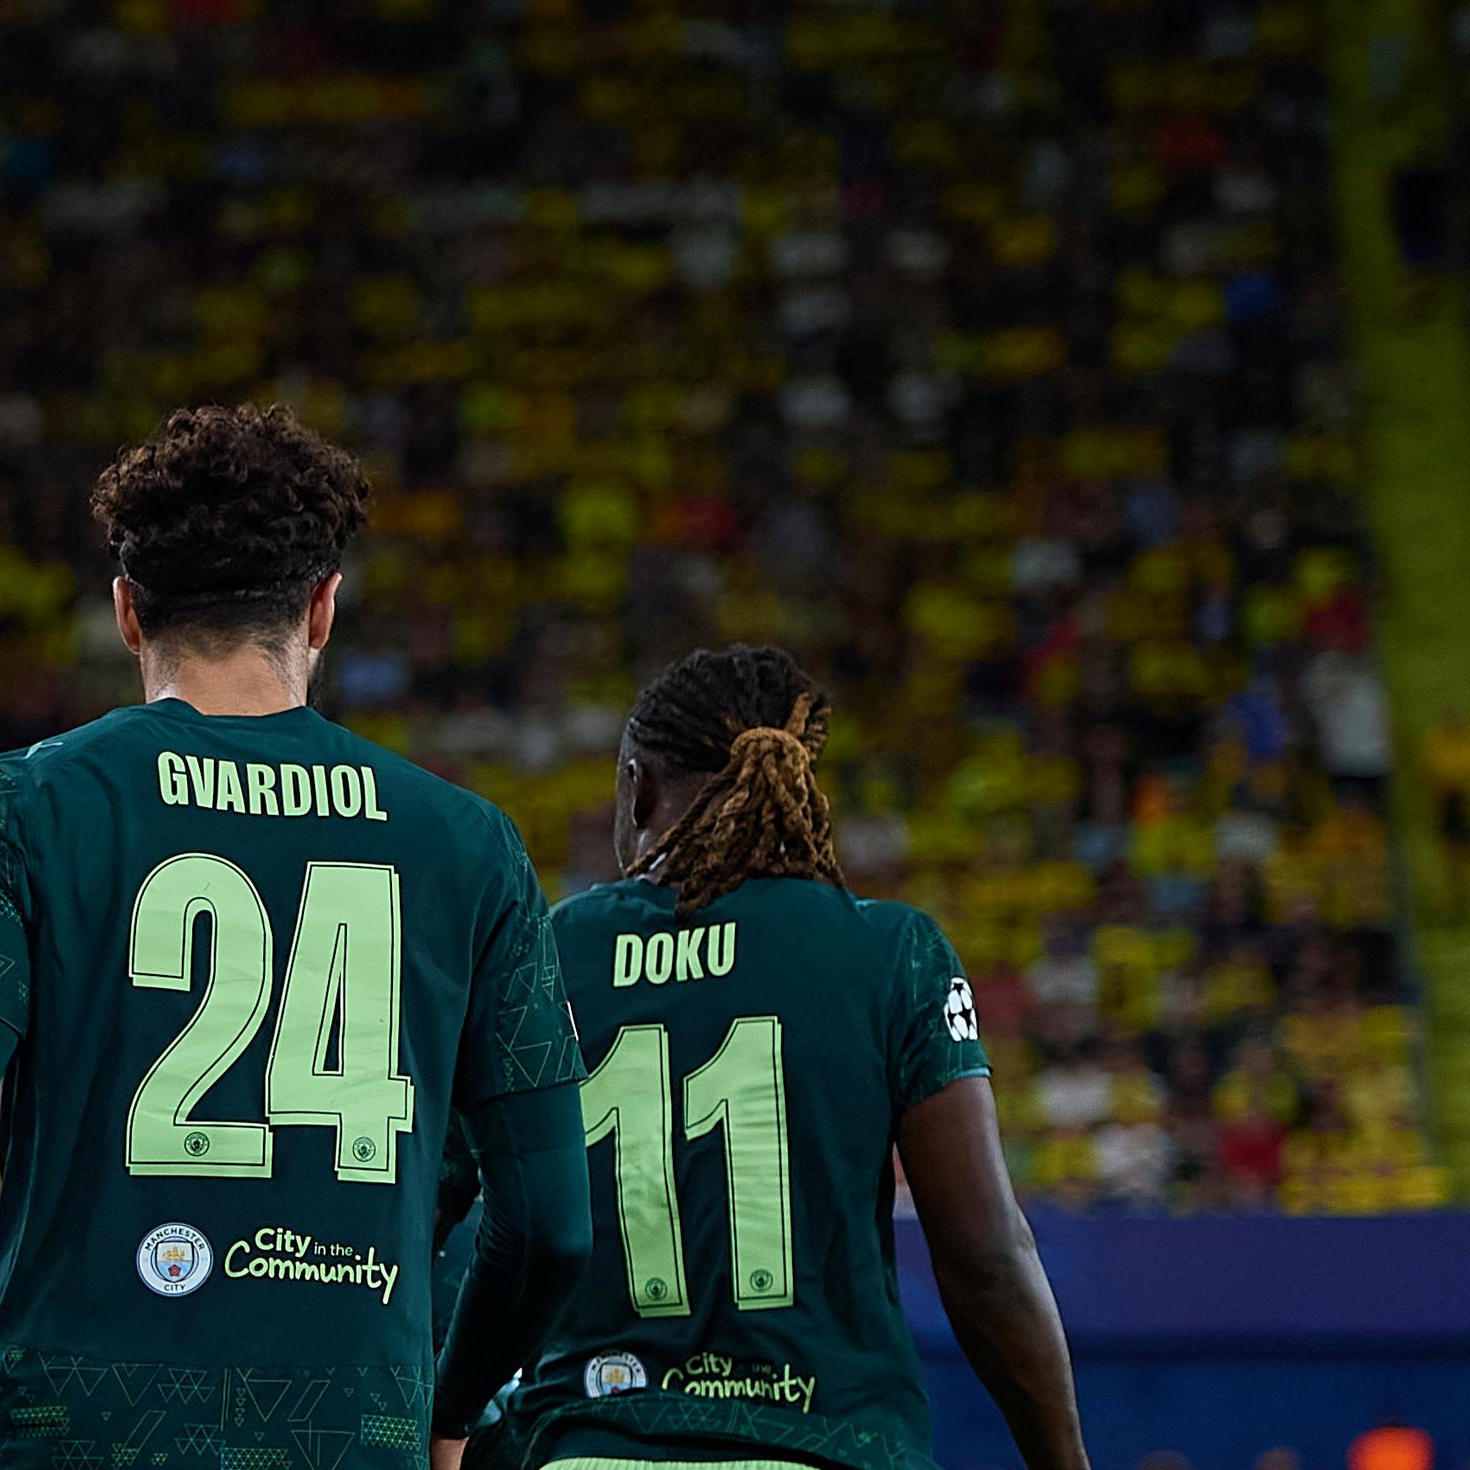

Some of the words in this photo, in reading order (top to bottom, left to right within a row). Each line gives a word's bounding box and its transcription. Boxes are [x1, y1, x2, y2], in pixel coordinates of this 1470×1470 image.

[157, 751, 388, 821] GVARDIOL
[613, 922, 736, 987] DOKU
[125, 853, 415, 1183] 24
[579, 1015, 793, 1317] 11
[145, 1227, 205, 1251] MANCHESTER
[255, 1228, 311, 1258] City
[314, 1242, 327, 1256] in
[330, 1243, 354, 1257] the
[164, 1284, 186, 1292] CITY
[225, 1247, 398, 1304] Community
[686, 1352, 732, 1377] City
